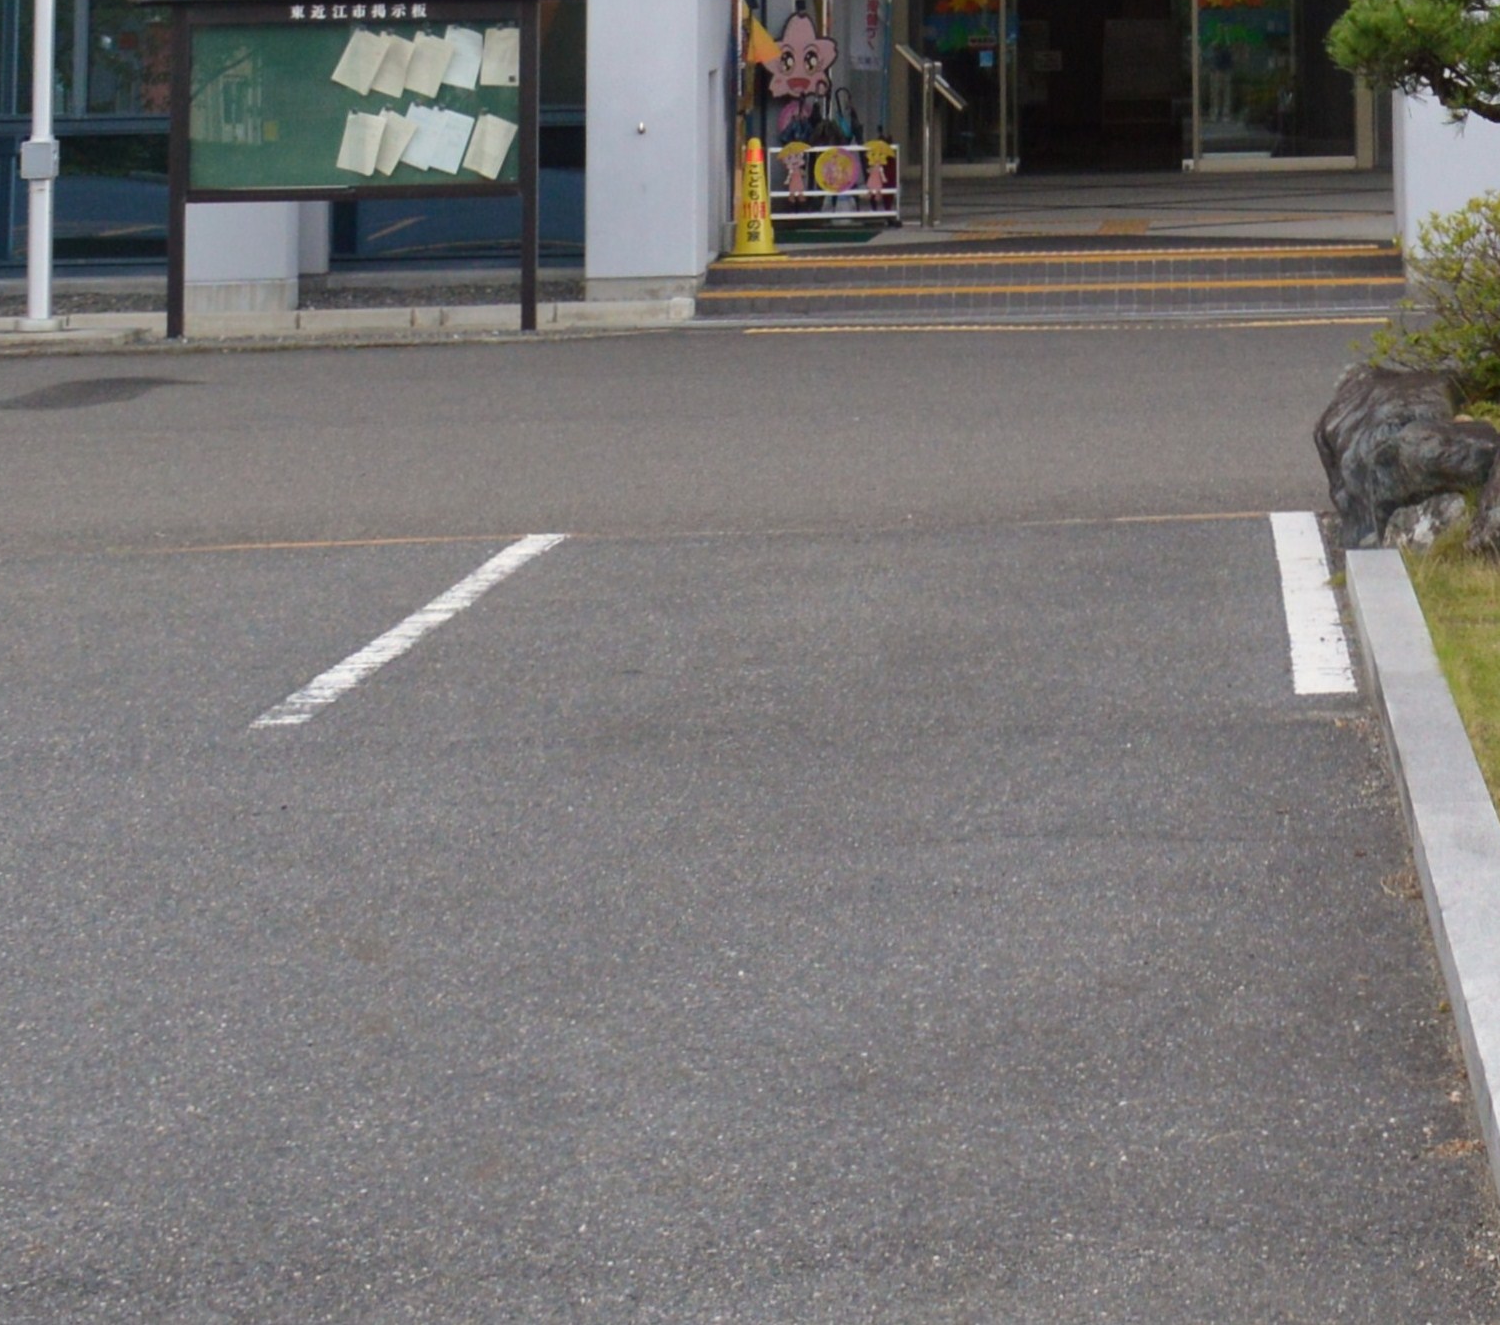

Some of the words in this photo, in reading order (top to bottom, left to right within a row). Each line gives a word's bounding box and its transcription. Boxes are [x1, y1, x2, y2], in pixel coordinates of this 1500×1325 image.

[290, 2, 427, 20] 東近江市掲示板
